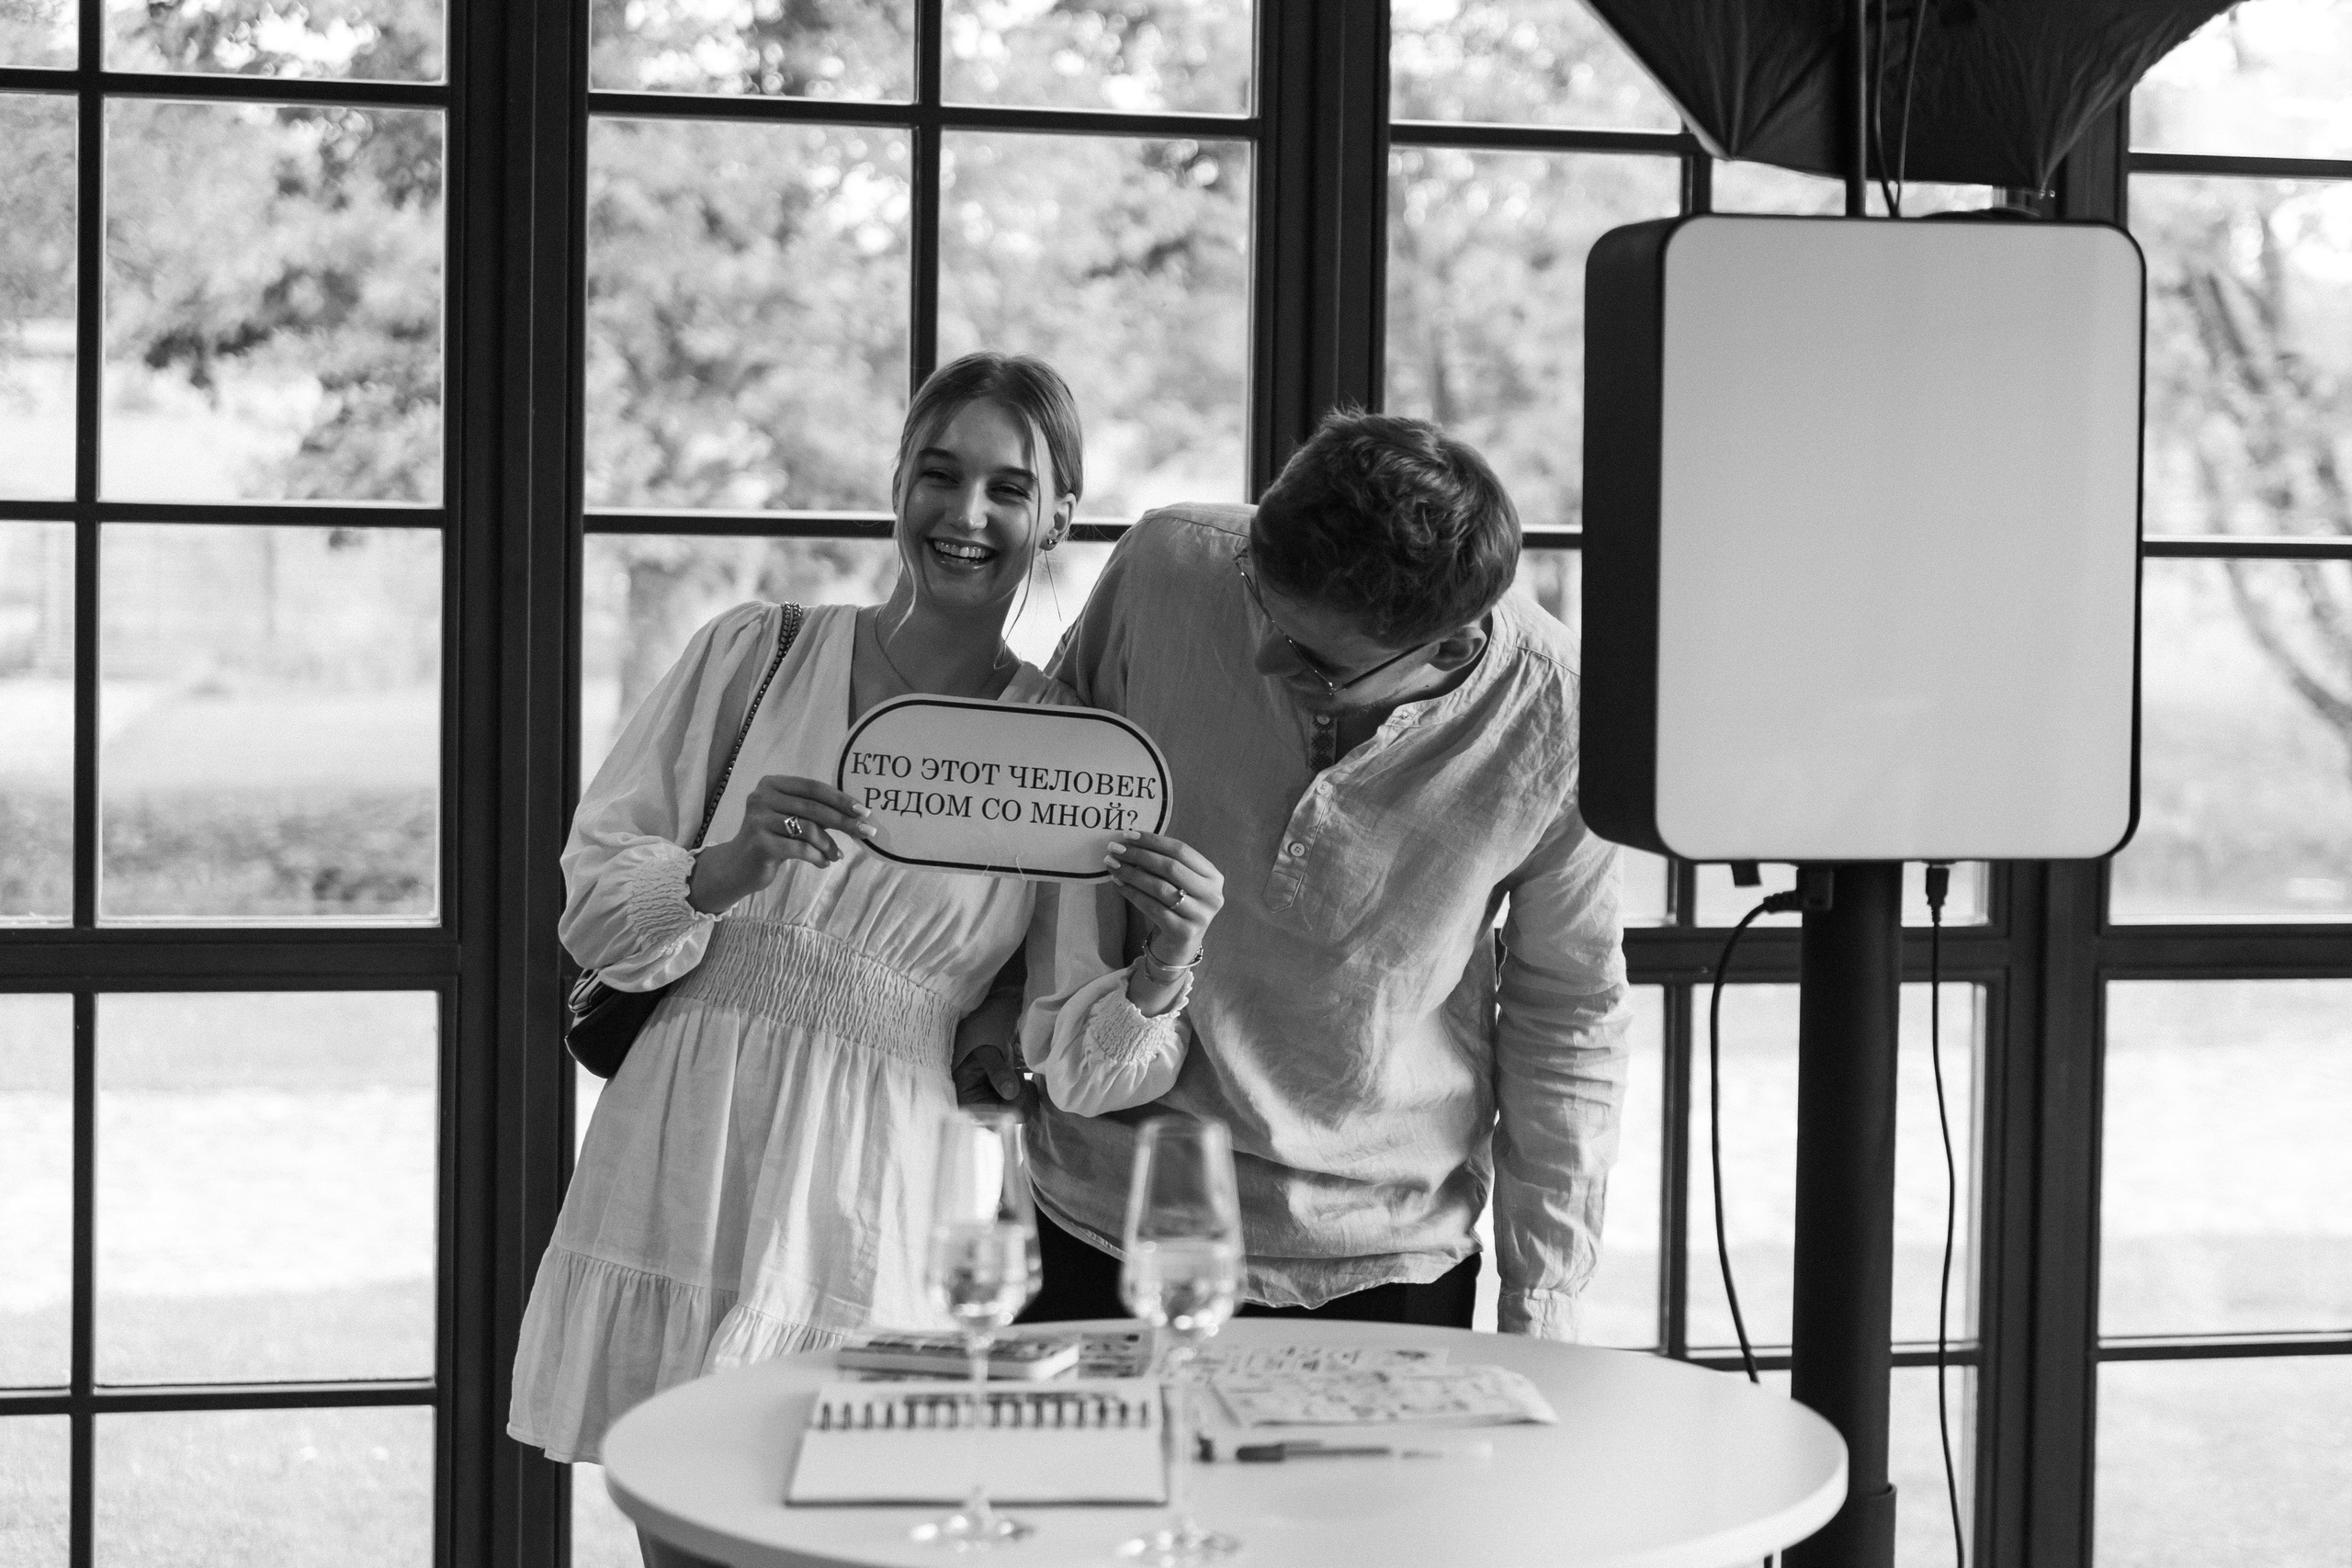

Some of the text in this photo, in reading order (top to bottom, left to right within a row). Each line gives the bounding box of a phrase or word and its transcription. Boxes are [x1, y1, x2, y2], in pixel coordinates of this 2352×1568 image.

[850, 751, 1158, 800] КТО ЭТОТ ЧЕЛОВЕК
[863, 786, 1139, 831] РЯДОМ СО МНОЙ?
